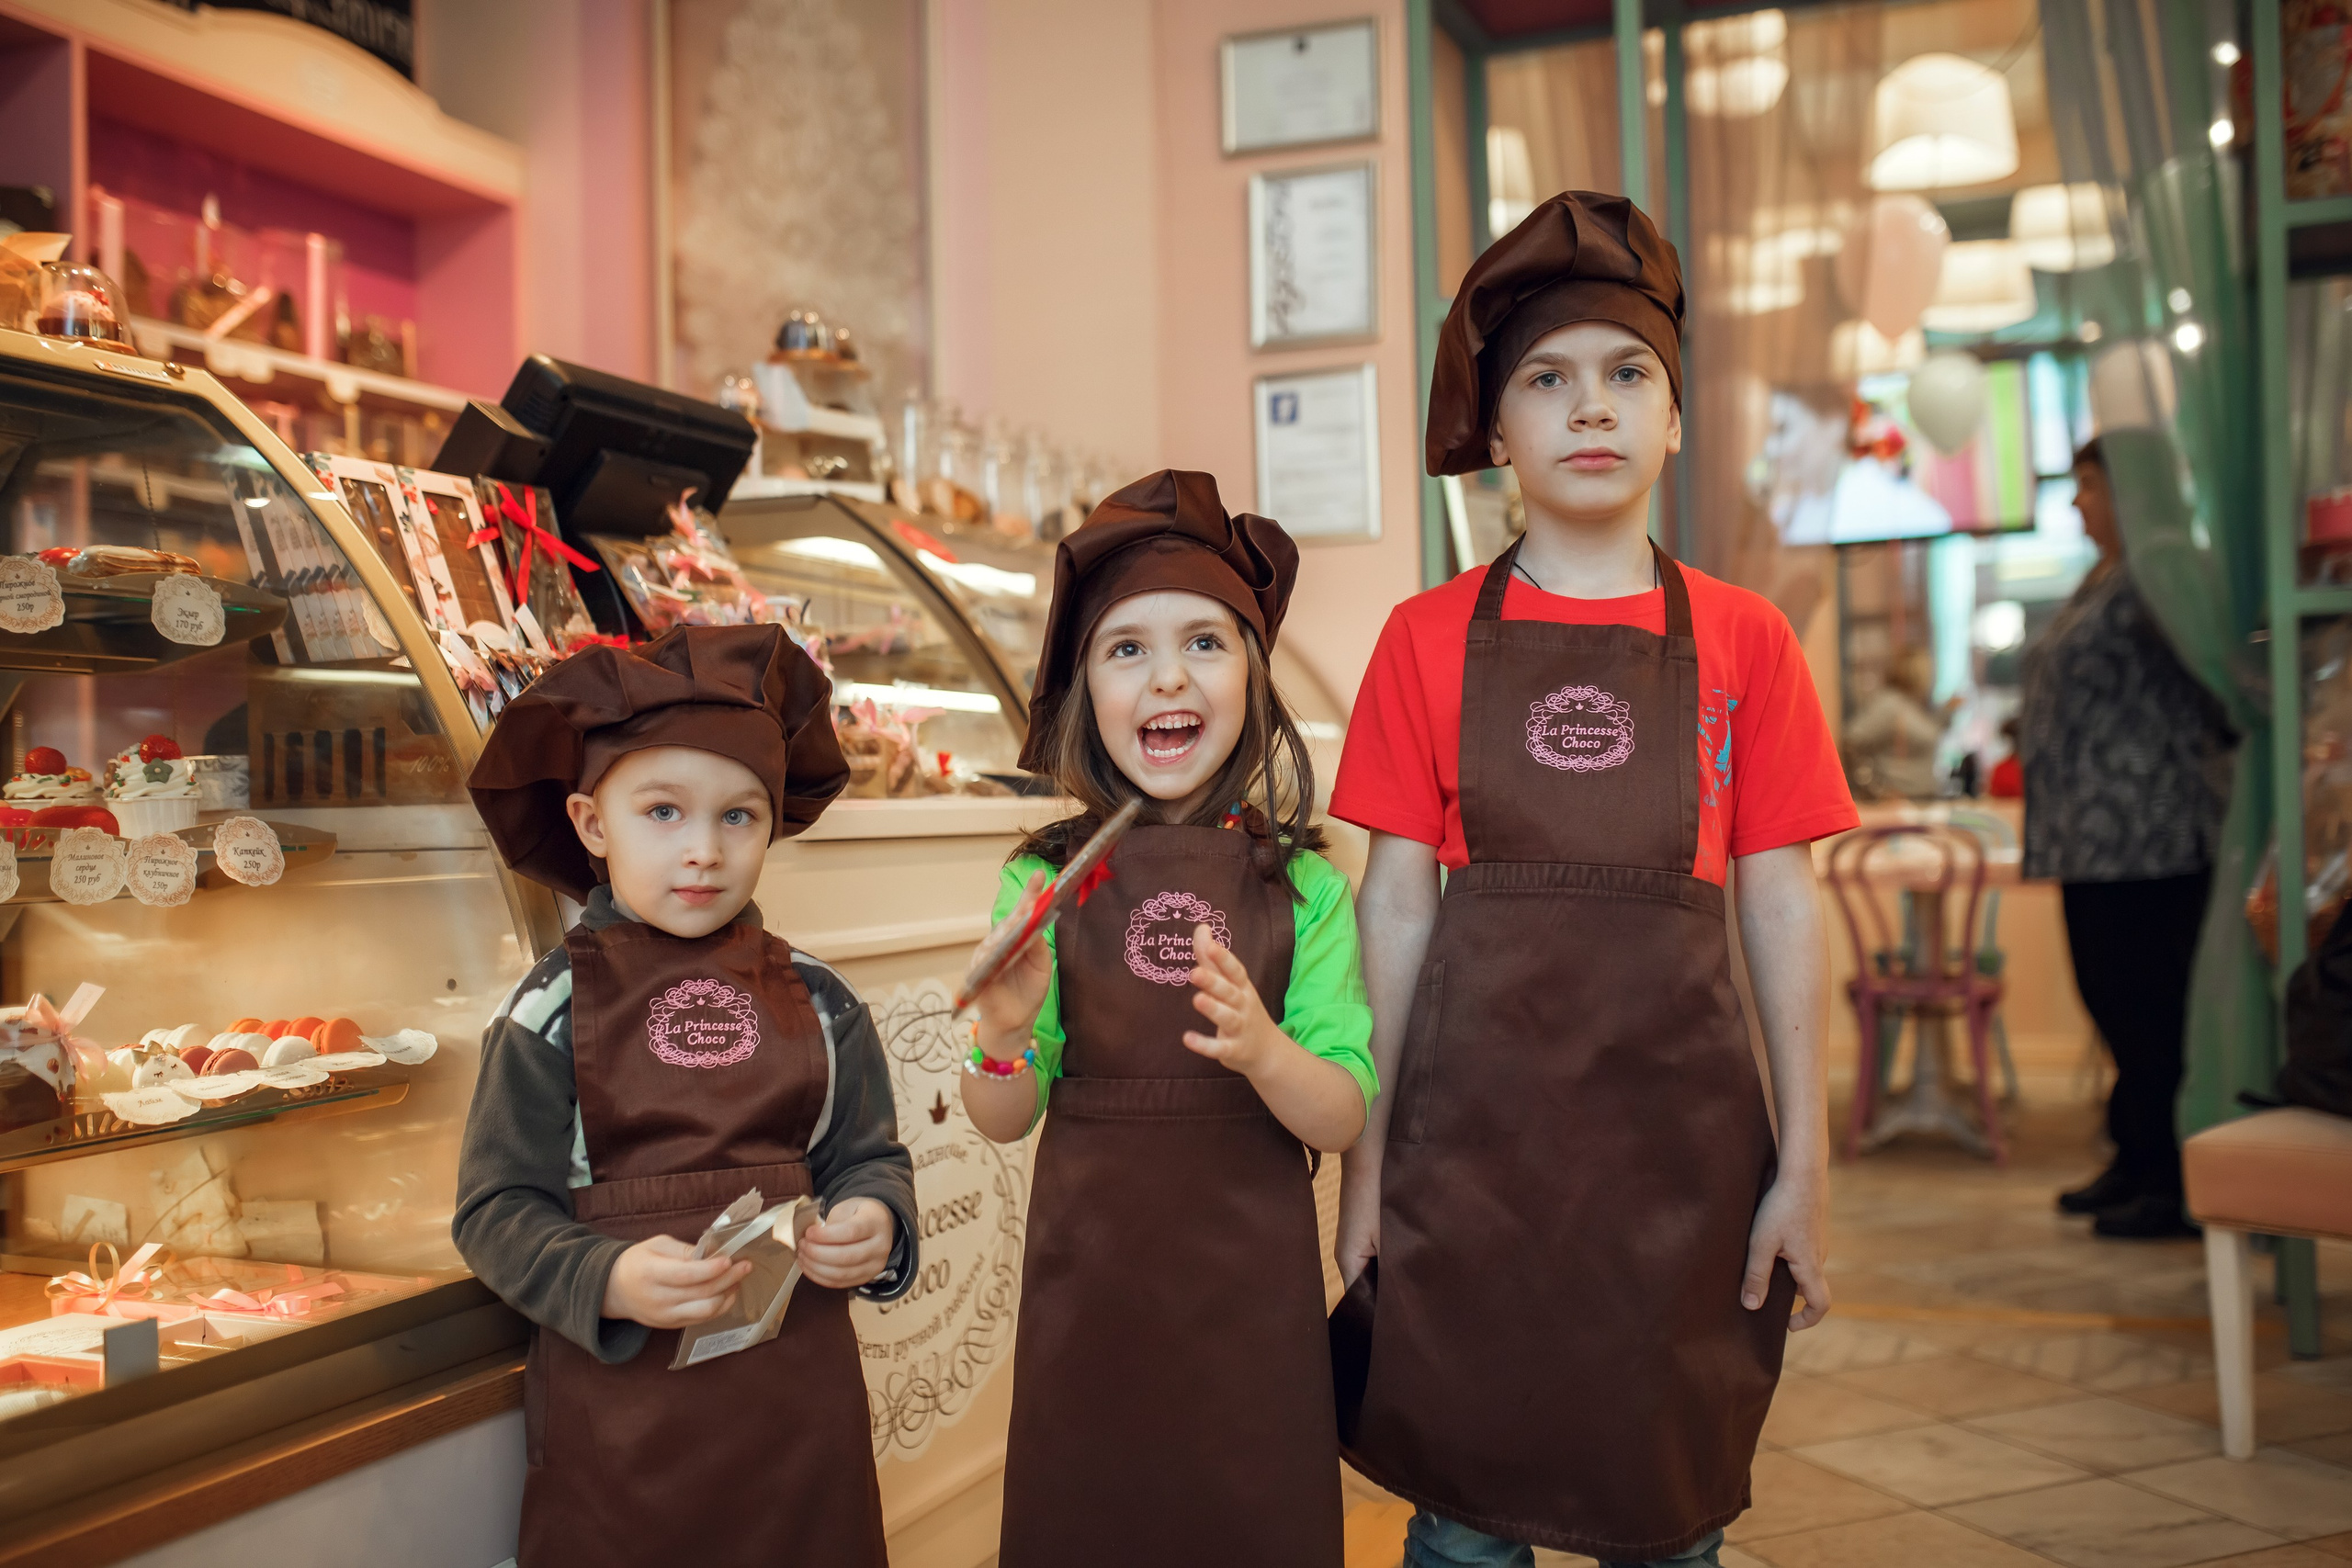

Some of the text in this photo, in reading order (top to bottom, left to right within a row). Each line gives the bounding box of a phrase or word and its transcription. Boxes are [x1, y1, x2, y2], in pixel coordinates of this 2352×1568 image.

[175, 620, 204, 633] 170 руб
[1541, 724, 1618, 736] La Princesse
[1562, 737, 1600, 749] Choco
[410, 755, 450, 774] 100%
[68, 853, 105, 862] Малиновое
[232, 846, 266, 857] Капкейк
[144, 855, 178, 866] Пирожное
[75, 863, 96, 873] сердце
[143, 868, 180, 878] клубничное
[74, 874, 102, 886] 250 руб
[1139, 933, 1194, 946] La Princ
[664, 1019, 742, 1034] La Princesse
[687, 1032, 726, 1045] Choco
[918, 1190, 982, 1241] cesse
